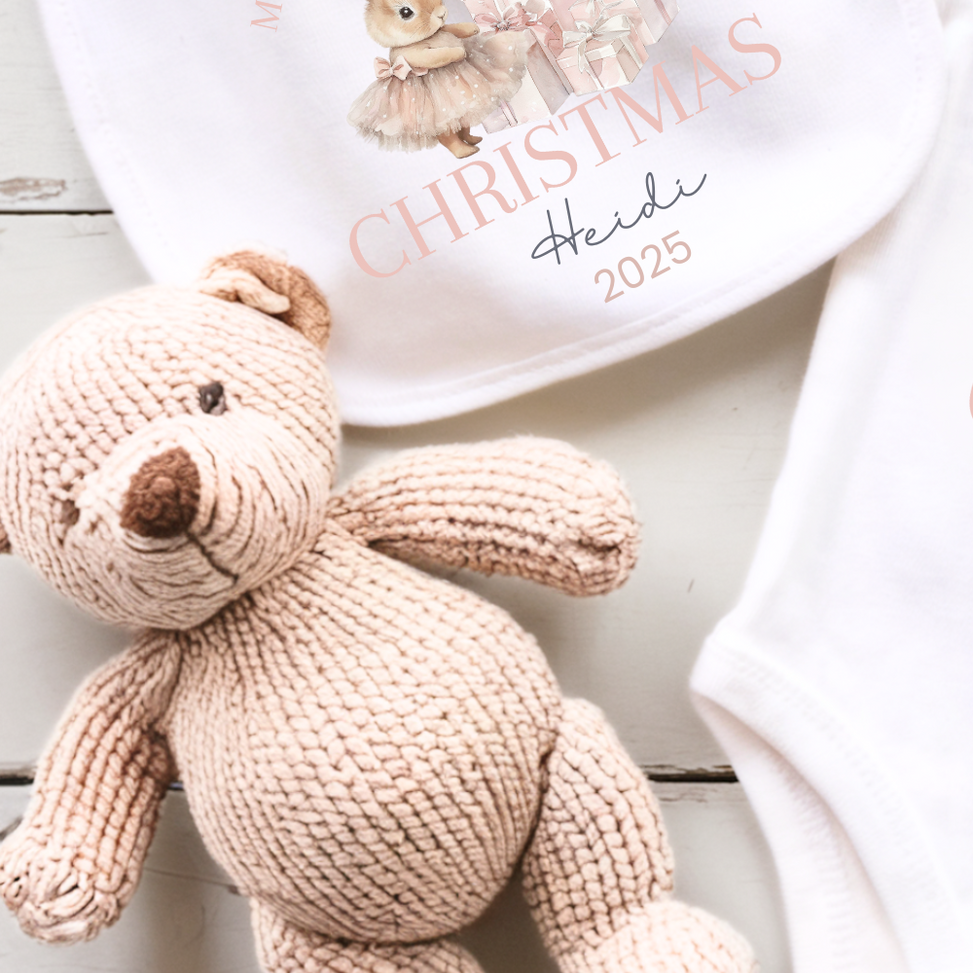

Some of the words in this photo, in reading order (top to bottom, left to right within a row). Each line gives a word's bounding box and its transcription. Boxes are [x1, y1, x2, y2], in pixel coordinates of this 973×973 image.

[348, 13, 782, 279] CHRISTMAS
[531, 172, 707, 265] Heidi
[593, 230, 692, 303] 2025
